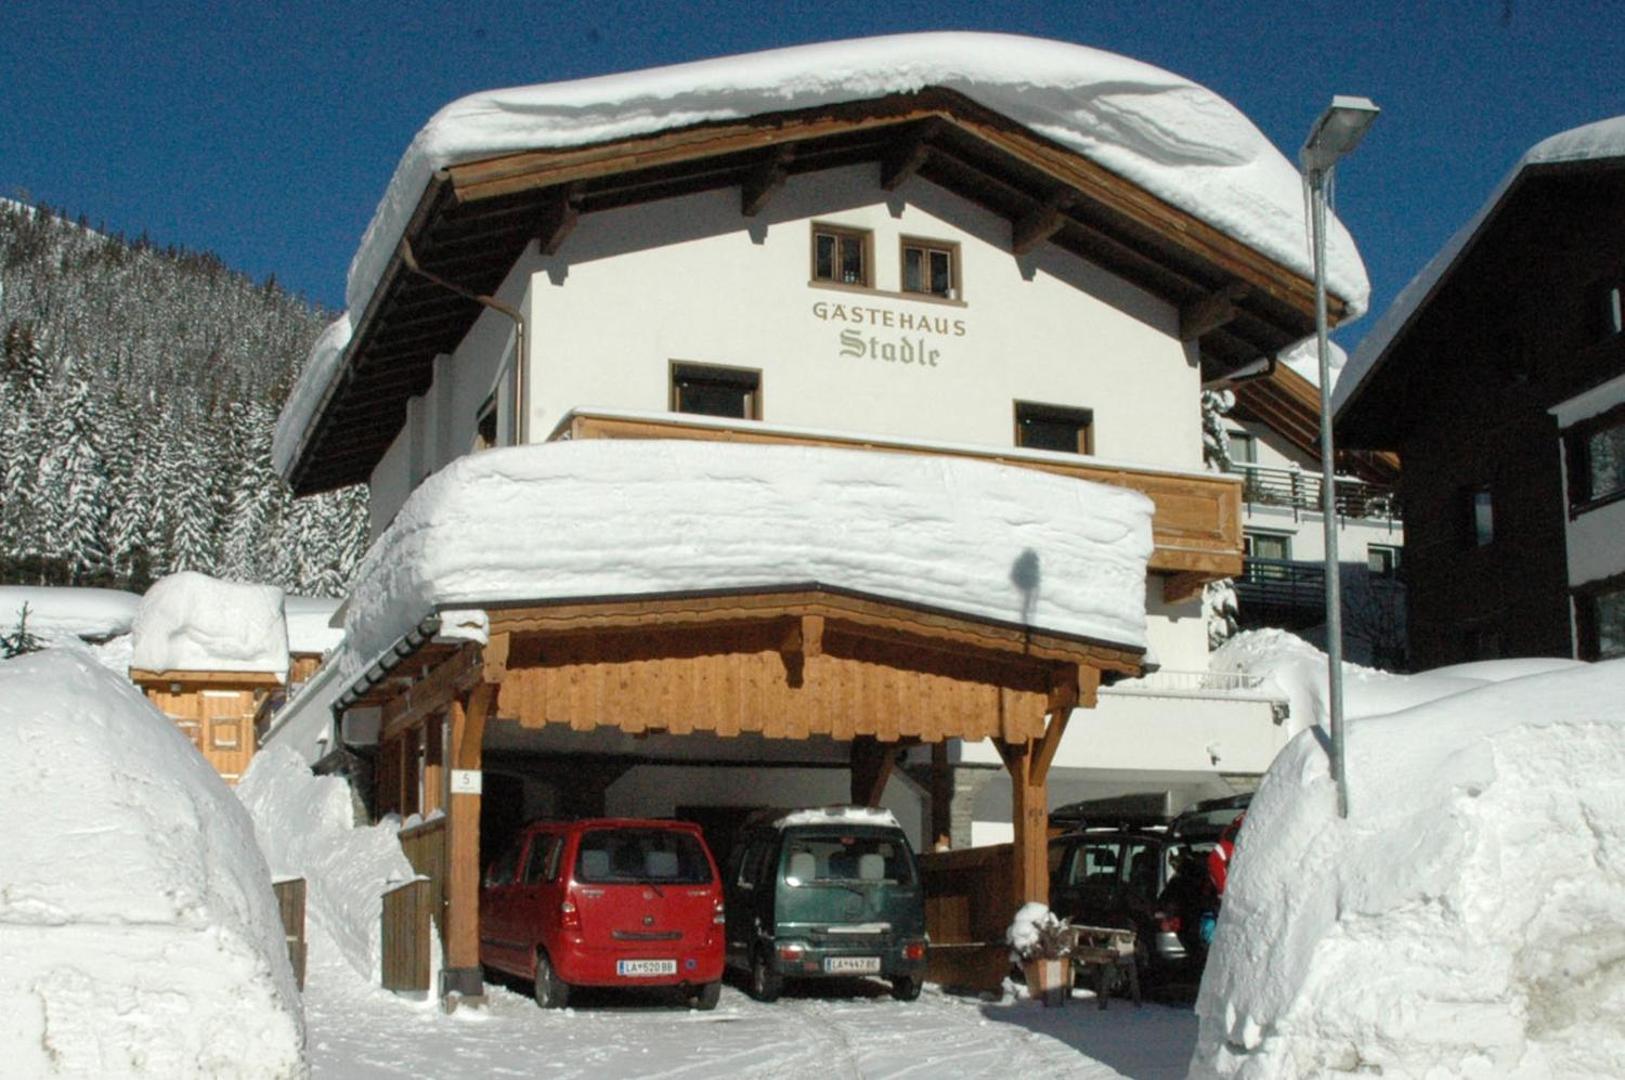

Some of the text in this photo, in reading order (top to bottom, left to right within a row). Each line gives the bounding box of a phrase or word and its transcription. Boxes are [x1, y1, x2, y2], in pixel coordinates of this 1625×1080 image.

[812, 301, 966, 337] GÄSTEHAUS
[839, 328, 941, 367] Stadle
[463, 773, 470, 785] 5
